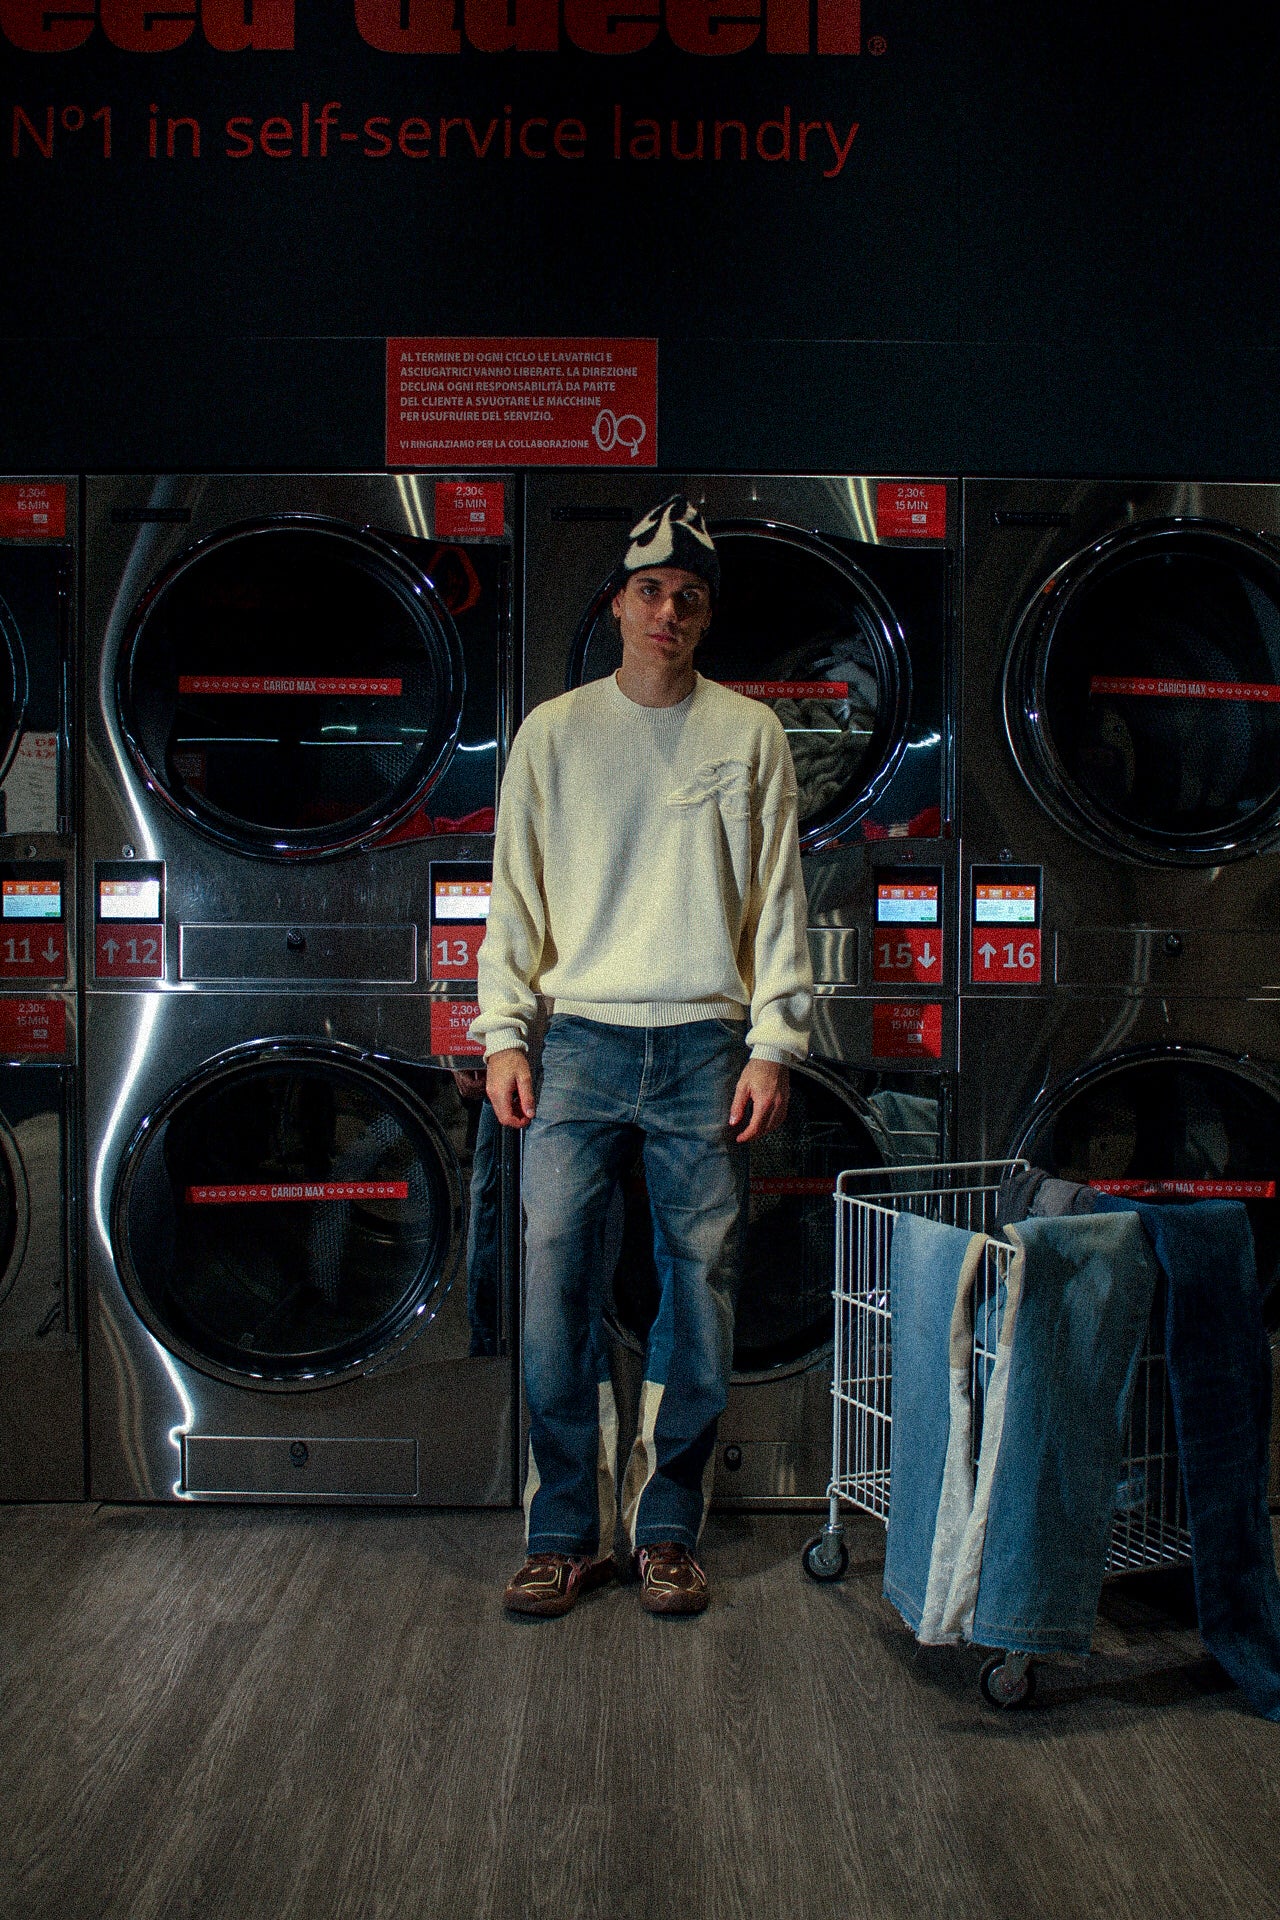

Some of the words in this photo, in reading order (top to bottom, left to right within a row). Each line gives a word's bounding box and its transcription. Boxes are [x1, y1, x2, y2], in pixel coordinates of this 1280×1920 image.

[148, 102, 202, 159] in
[225, 101, 587, 160] self-service
[613, 104, 861, 179] laundry
[400, 352, 414, 362] AL
[415, 352, 461, 362] TERMINE
[463, 352, 475, 362] DI
[476, 352, 503, 362] OGNI
[505, 352, 536, 362] CICLO
[538, 352, 550, 362] LE
[552, 352, 605, 362] LAVATRICI
[606, 352, 613, 362] E
[400, 367, 473, 377] ASCIUGATRICI
[473, 367, 511, 377] VANNO
[566, 367, 580, 377] LA
[582, 367, 638, 377] DIREZIONE
[400, 381, 445, 392] DECLINA
[446, 381, 474, 392] OGNI
[475, 379, 564, 392] RESPONSABILITÀ
[566, 381, 580, 392] DA
[583, 381, 616, 392] PARTE
[400, 396, 420, 407] DEL
[421, 396, 463, 407] CLIENTE
[465, 396, 474, 407] A
[475, 396, 531, 407] SVUOTARE
[532, 396, 545, 407] LE
[546, 396, 601, 407] MACCHINE
[400, 411, 420, 421] PER
[421, 411, 479, 421] USUFRUIRE
[481, 411, 501, 421] DEL
[400, 439, 409, 449] VI
[410, 439, 474, 449] RINGRAZIAMO
[476, 439, 493, 449] PER
[494, 439, 506, 449] LA
[508, 439, 589, 449] COLLABORAZIONE
[17, 501, 28, 510] 15
[28, 501, 50, 510] MIN
[454, 499, 465, 508] 15
[466, 499, 487, 508] MIN
[895, 501, 907, 510] 15
[907, 501, 929, 510] MIN
[263, 680, 295, 691] CARICO
[296, 681, 317, 691] MAX
[745, 684, 766, 695] MAX
[1157, 682, 1187, 693] CARICO
[1188, 684, 1207, 695] MAX
[3, 938, 35, 964] 11
[125, 938, 158, 964] 12
[437, 940, 469, 966] 13
[879, 942, 913, 968] 15
[1002, 942, 1035, 968] 16
[17, 1016, 28, 1025] 15
[29, 1016, 50, 1025] MIN
[449, 1018, 460, 1027] 15
[891, 1020, 903, 1030] 15
[903, 1020, 925, 1030] MIN
[271, 1187, 303, 1198] CARICO
[304, 1186, 325, 1197] MAX
[1175, 1183, 1195, 1193] MAX
